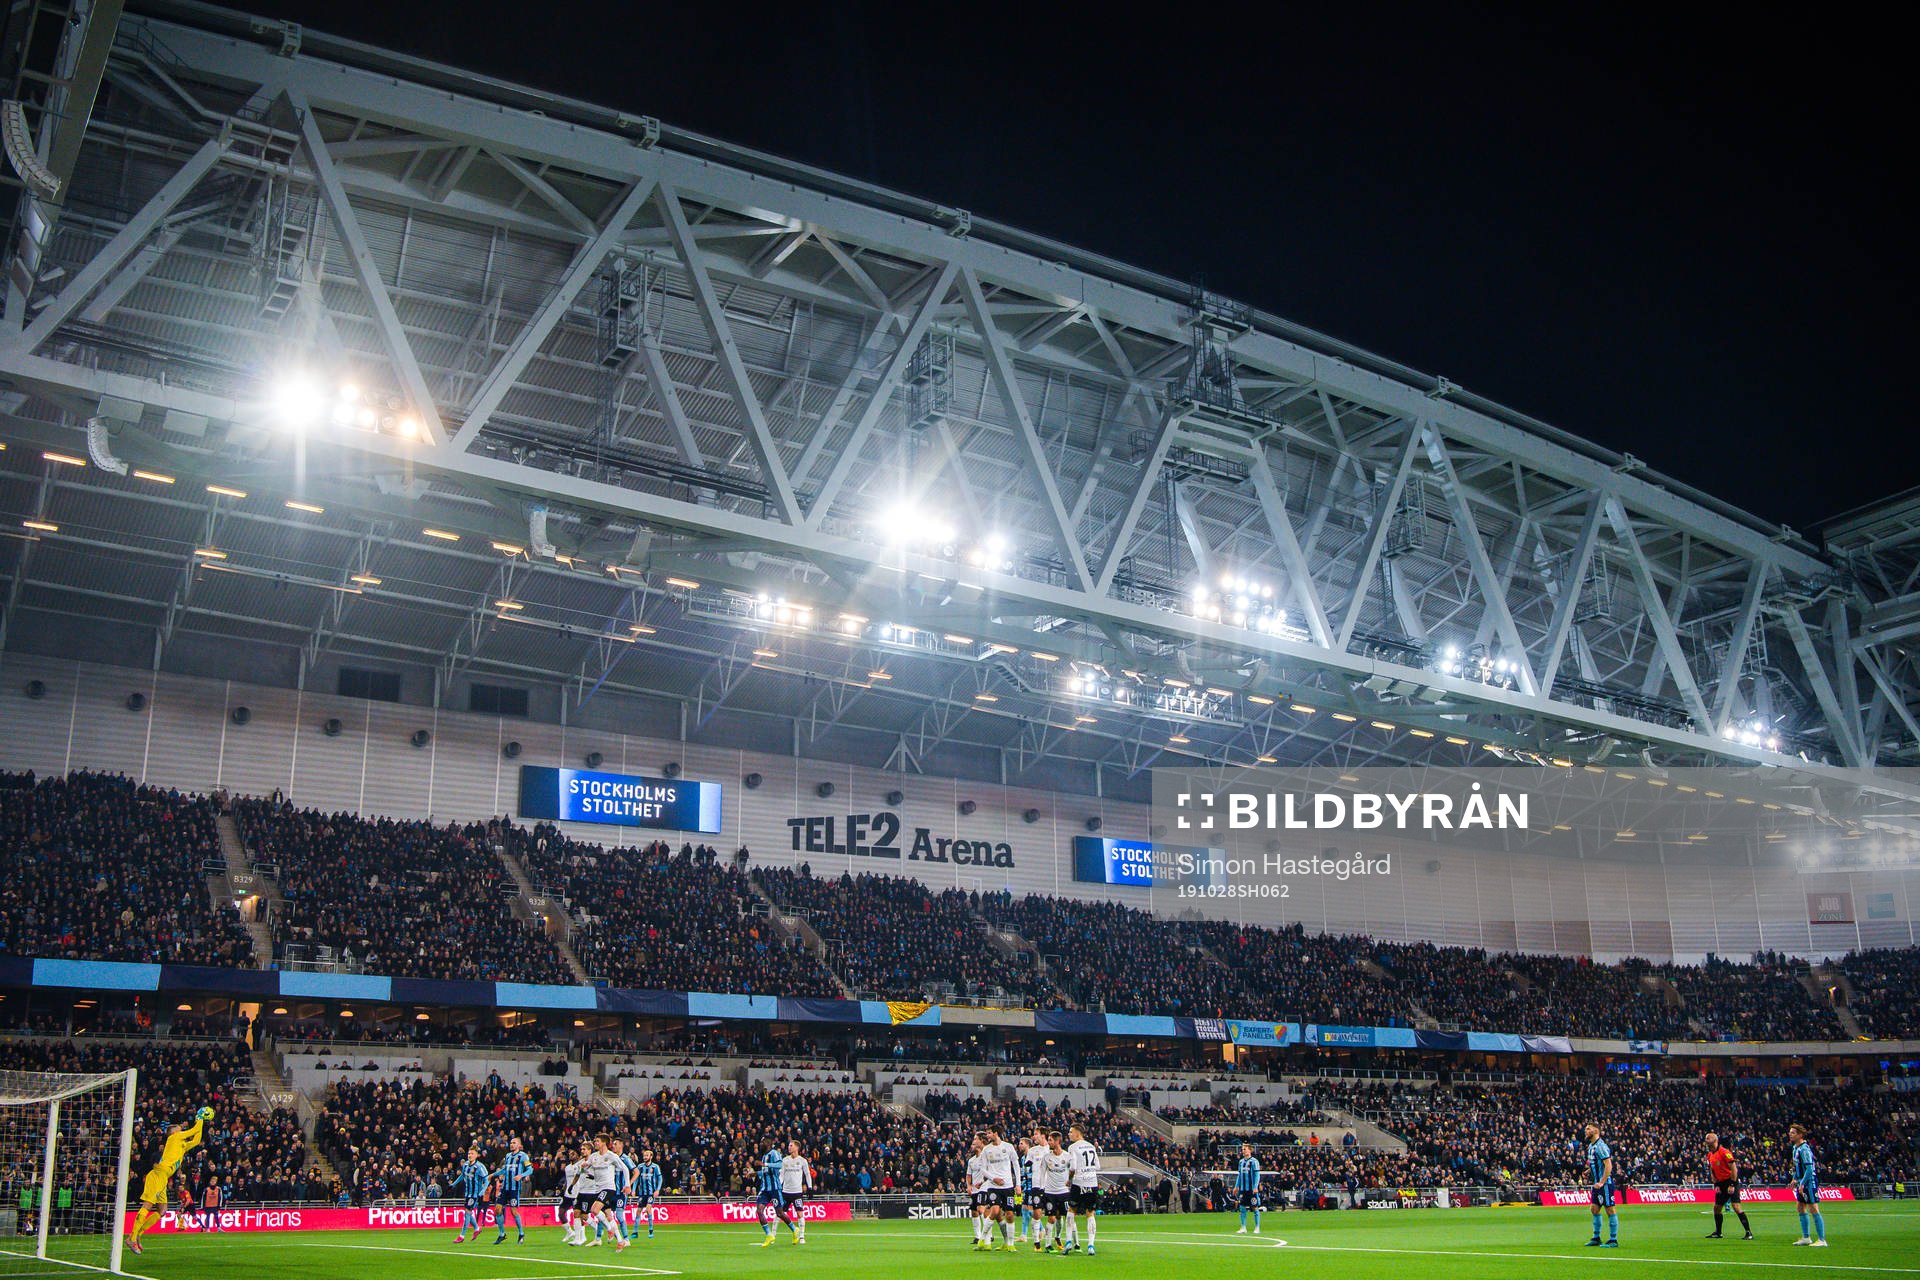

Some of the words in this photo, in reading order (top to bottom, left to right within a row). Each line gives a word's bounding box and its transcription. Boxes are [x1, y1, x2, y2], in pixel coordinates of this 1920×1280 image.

[569, 779, 676, 803] STOCKHOLMS
[582, 797, 663, 818] STOLTHET
[787, 811, 900, 858] TELE2
[908, 827, 1015, 868] Arena
[1818, 897, 1840, 911] JOB
[270, 1093, 294, 1103] A129
[1082, 1150, 1096, 1167] 12
[1367, 1199, 1398, 1209] stadium
[1554, 1191, 1590, 1204] Prioritet
[245, 1209, 302, 1227] Finans
[368, 1207, 441, 1225] Prioritet
[908, 1202, 972, 1220] stadium
